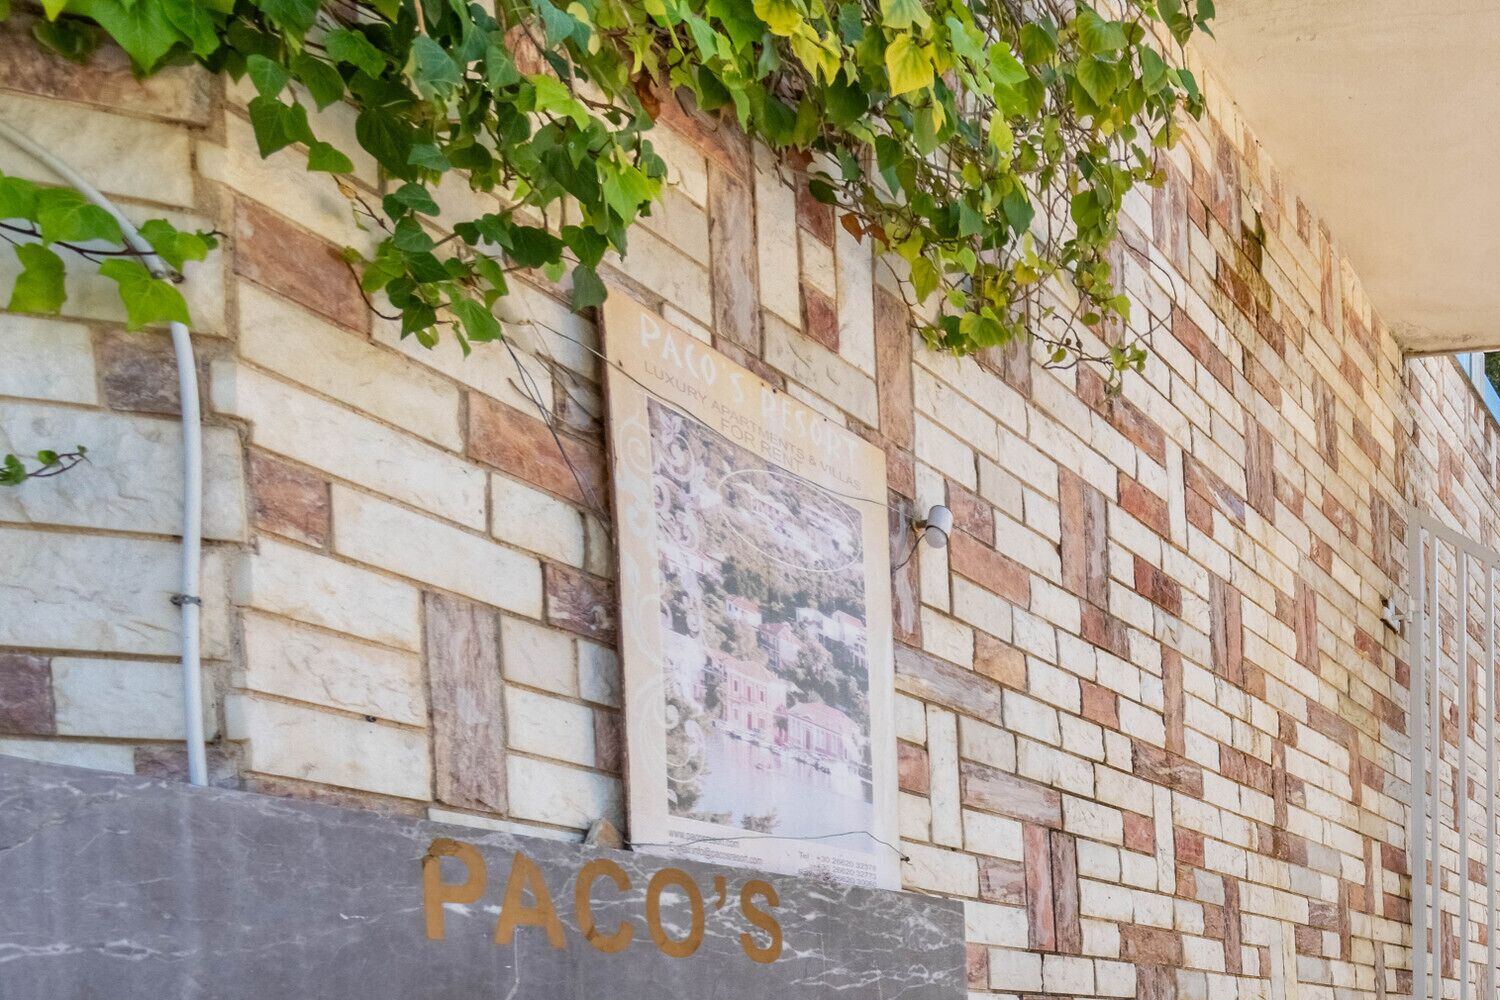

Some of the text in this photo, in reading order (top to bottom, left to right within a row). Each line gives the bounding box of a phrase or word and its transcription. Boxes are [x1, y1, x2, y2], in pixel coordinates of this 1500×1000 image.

[639, 312, 745, 402] PACO'S
[644, 359, 862, 492] LUXURY APARTMENTS & VILLAS
[720, 417, 803, 475] FOR RENT
[421, 836, 783, 965] PACO'S
